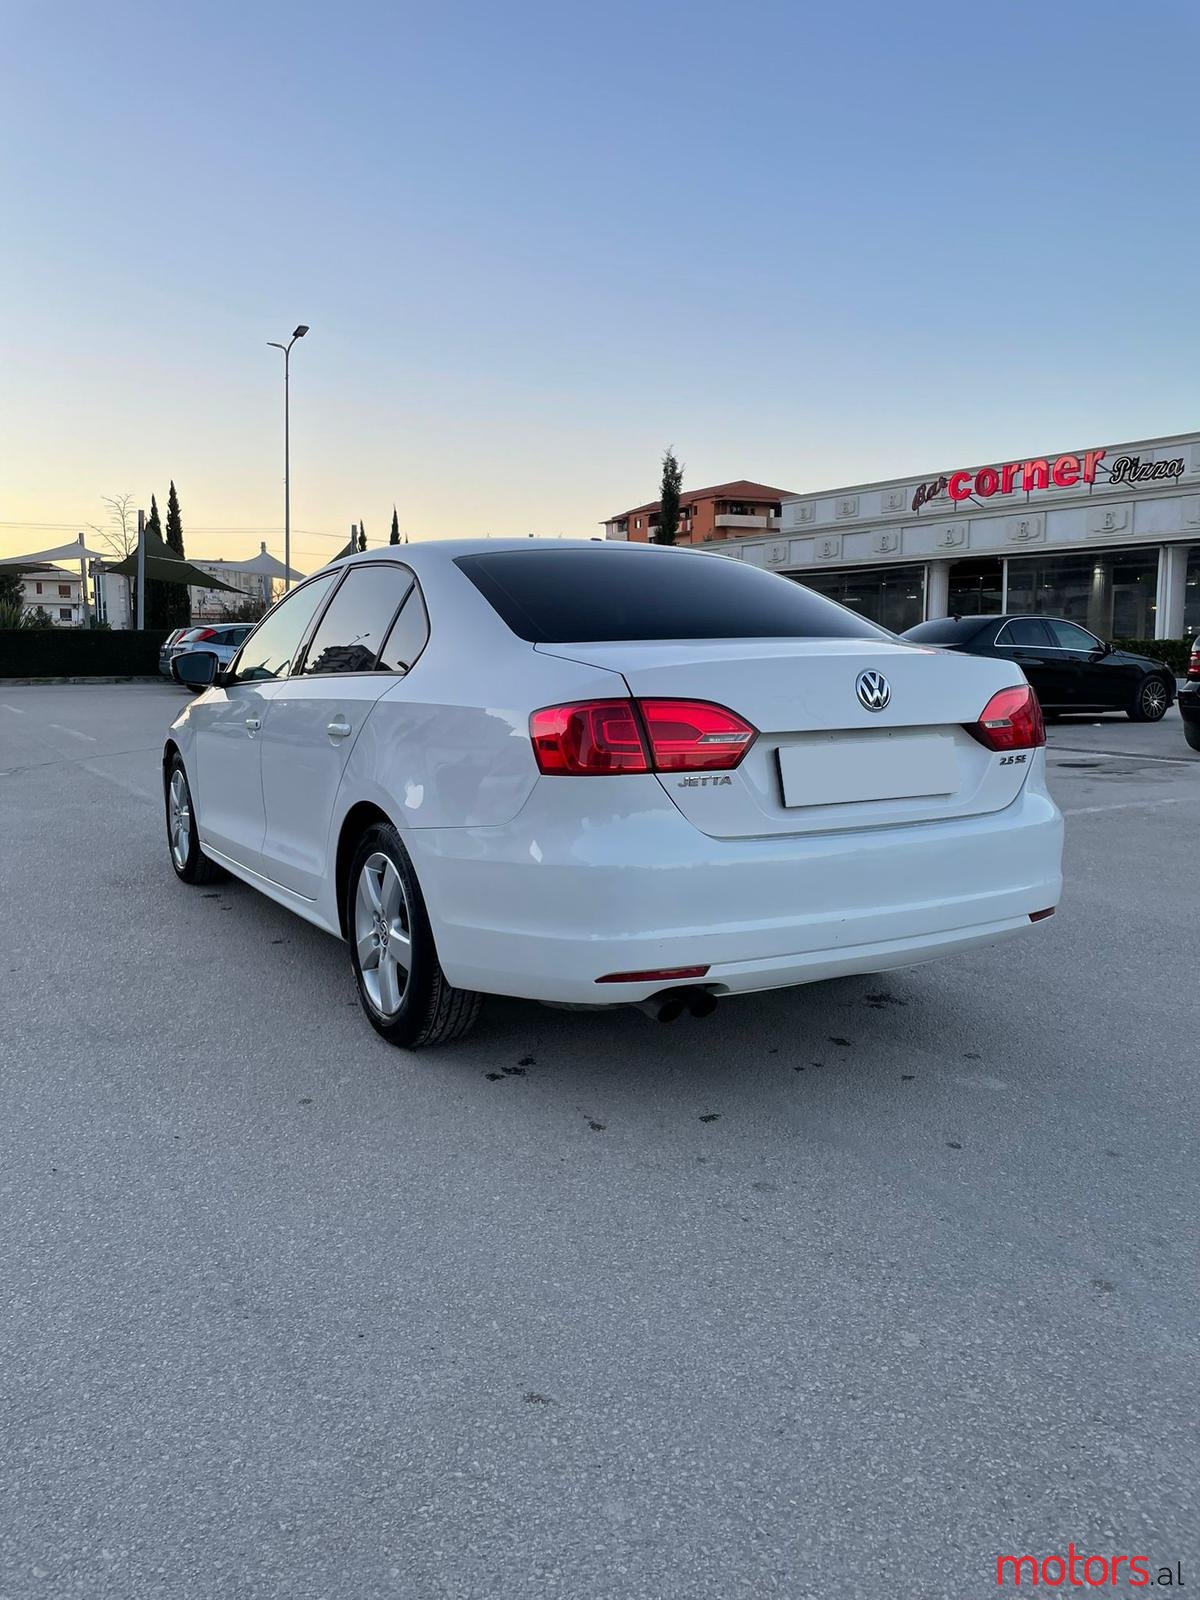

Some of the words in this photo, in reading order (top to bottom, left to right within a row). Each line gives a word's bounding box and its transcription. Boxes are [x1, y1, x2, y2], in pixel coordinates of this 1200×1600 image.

[911, 476, 948, 511] Bar
[948, 450, 1106, 500] corner
[1109, 456, 1184, 485] Pizza
[1014, 754, 1027, 765] SE
[677, 775, 732, 787] JETTA
